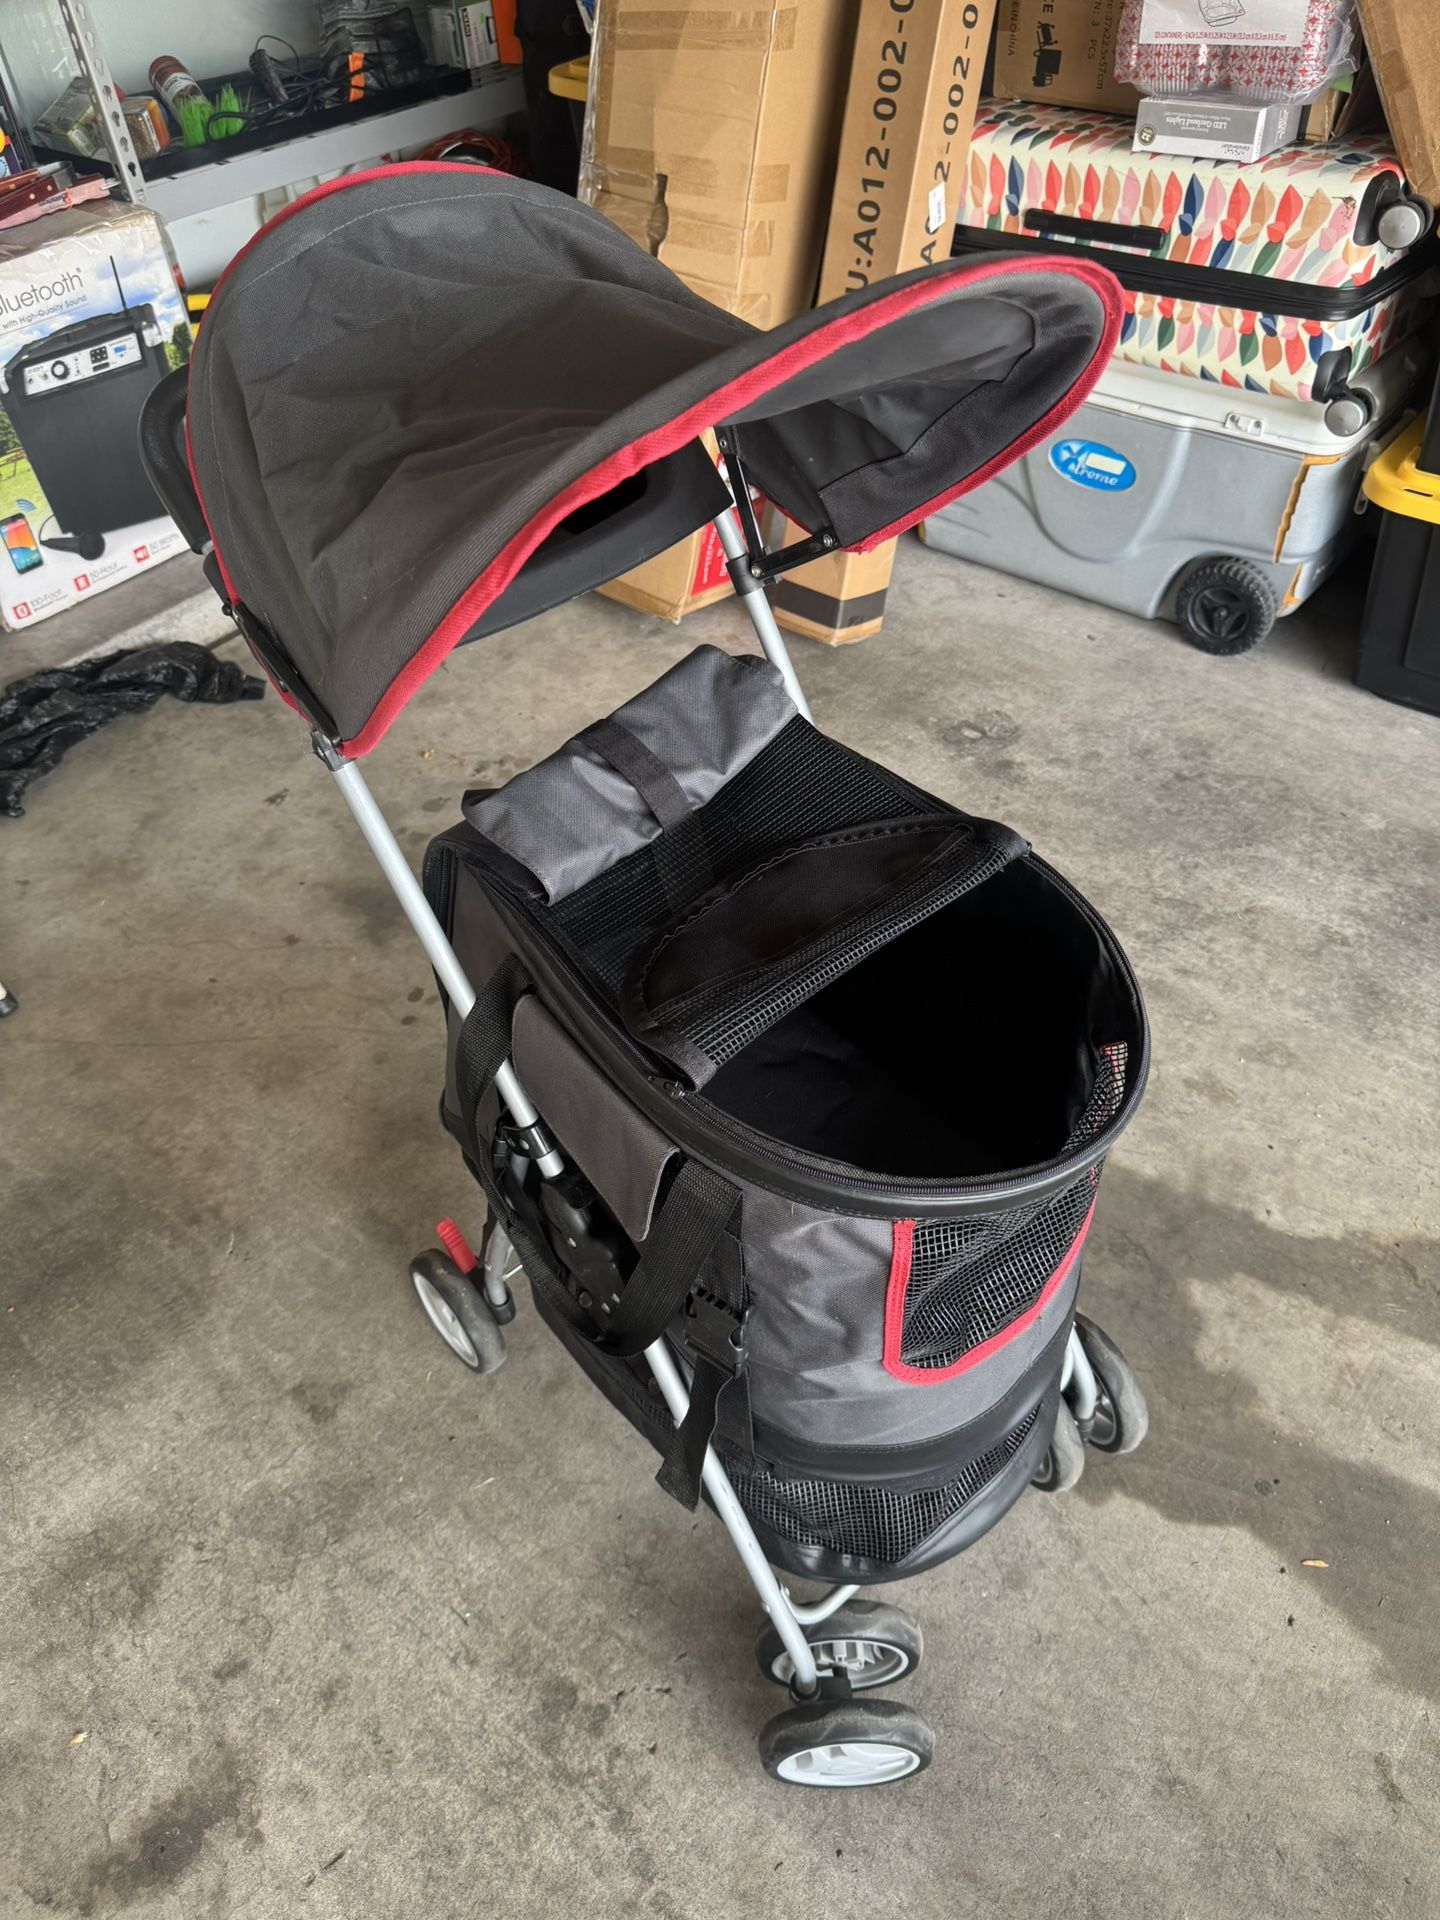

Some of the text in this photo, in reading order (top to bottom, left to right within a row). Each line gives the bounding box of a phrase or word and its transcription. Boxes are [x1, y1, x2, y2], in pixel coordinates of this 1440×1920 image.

[1088, 39, 1097, 60] PCS
[1166, 116, 1187, 126] Lights
[1187, 118, 1212, 129] Garland
[1212, 121, 1228, 130] LED
[1140, 132, 1152, 142] 32
[2, 295, 88, 329] with High-Quality Sound
